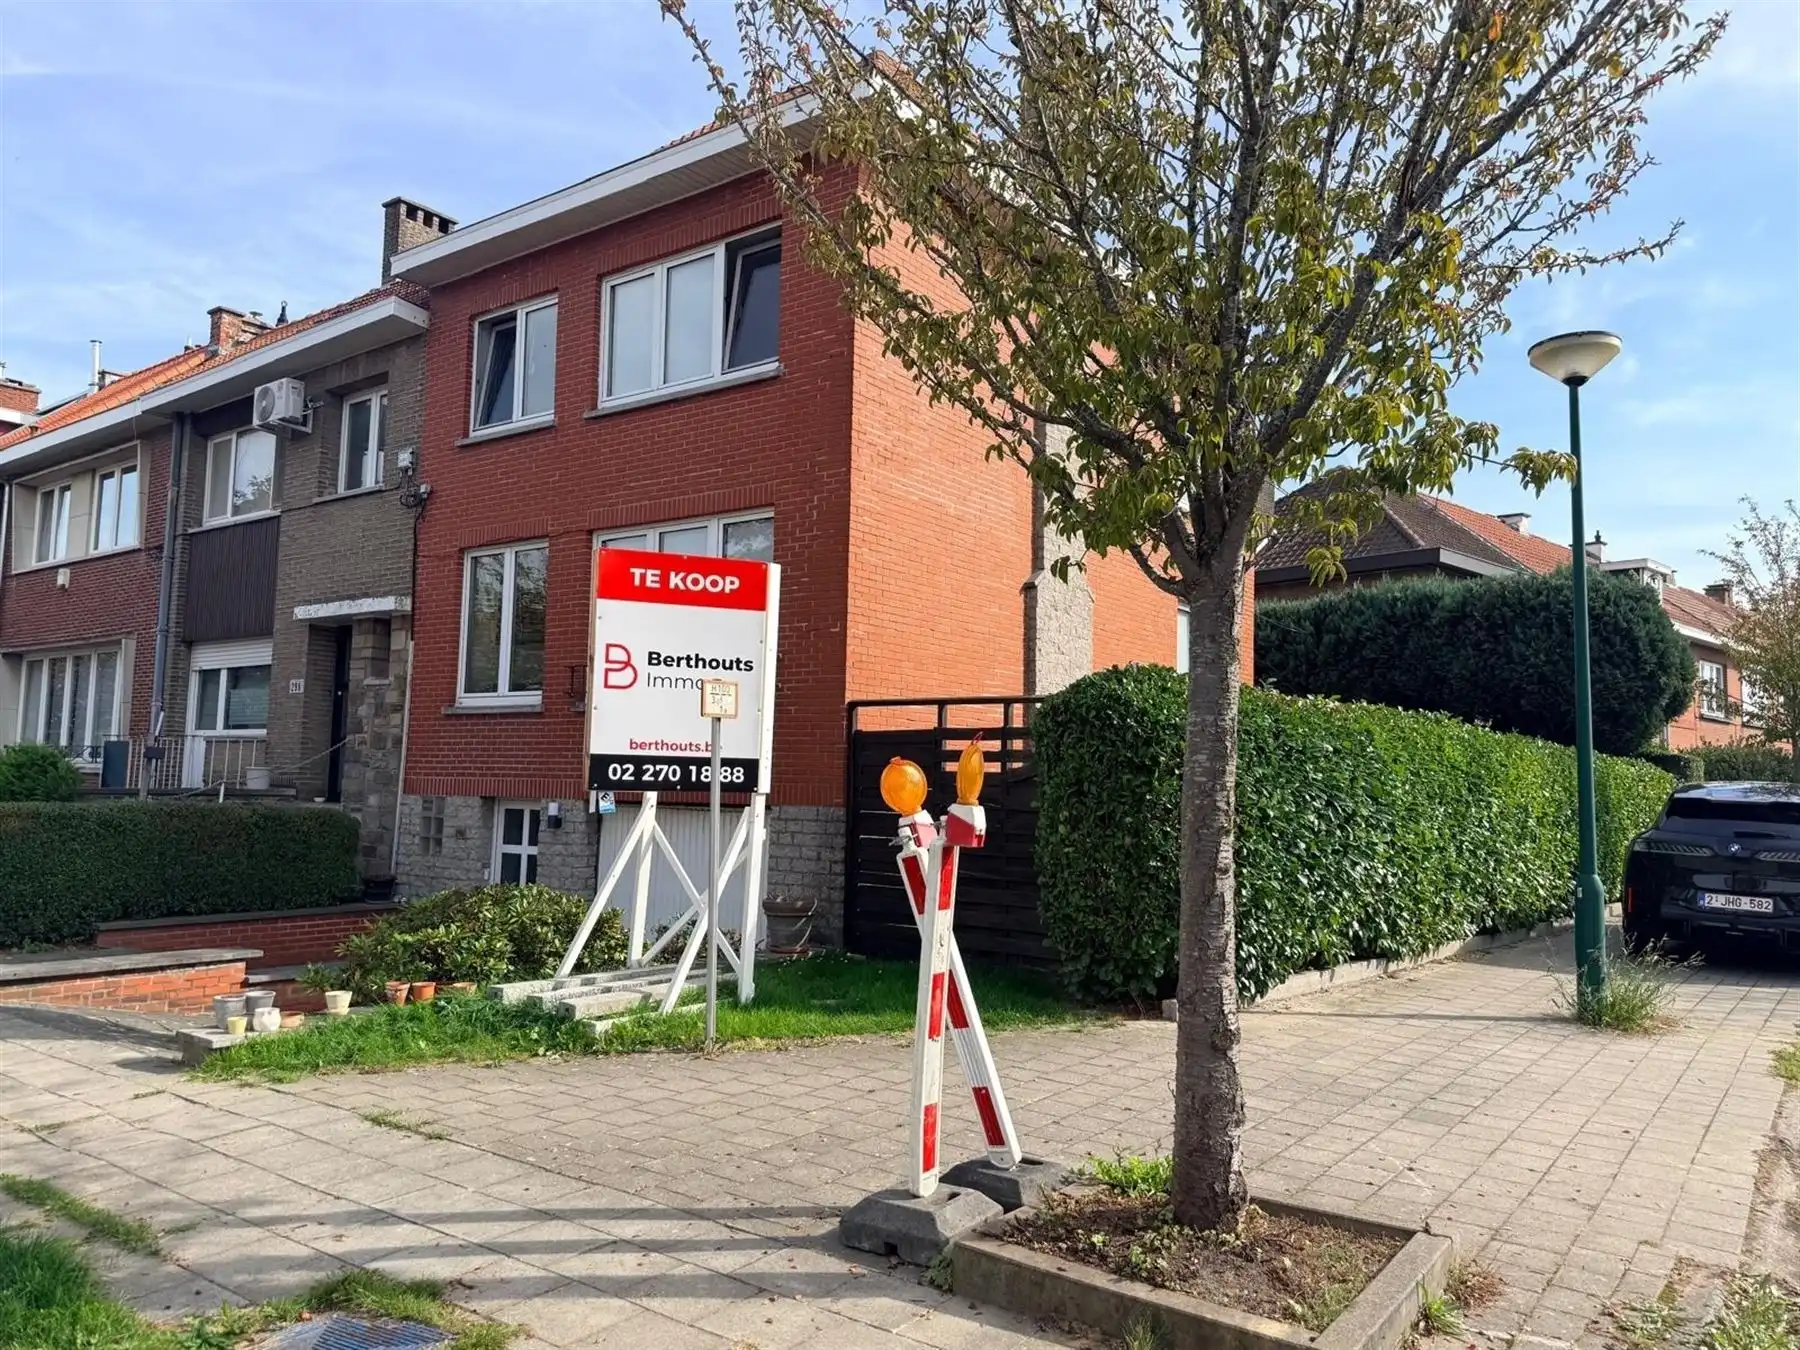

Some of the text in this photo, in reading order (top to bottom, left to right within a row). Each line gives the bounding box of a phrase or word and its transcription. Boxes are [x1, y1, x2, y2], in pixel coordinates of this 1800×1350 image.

[630, 567, 740, 594] TE KOOP
[647, 651, 754, 672] Berthouts
[629, 738, 723, 753] berthouts.b
[608, 763, 745, 783] 02 270 18 88
